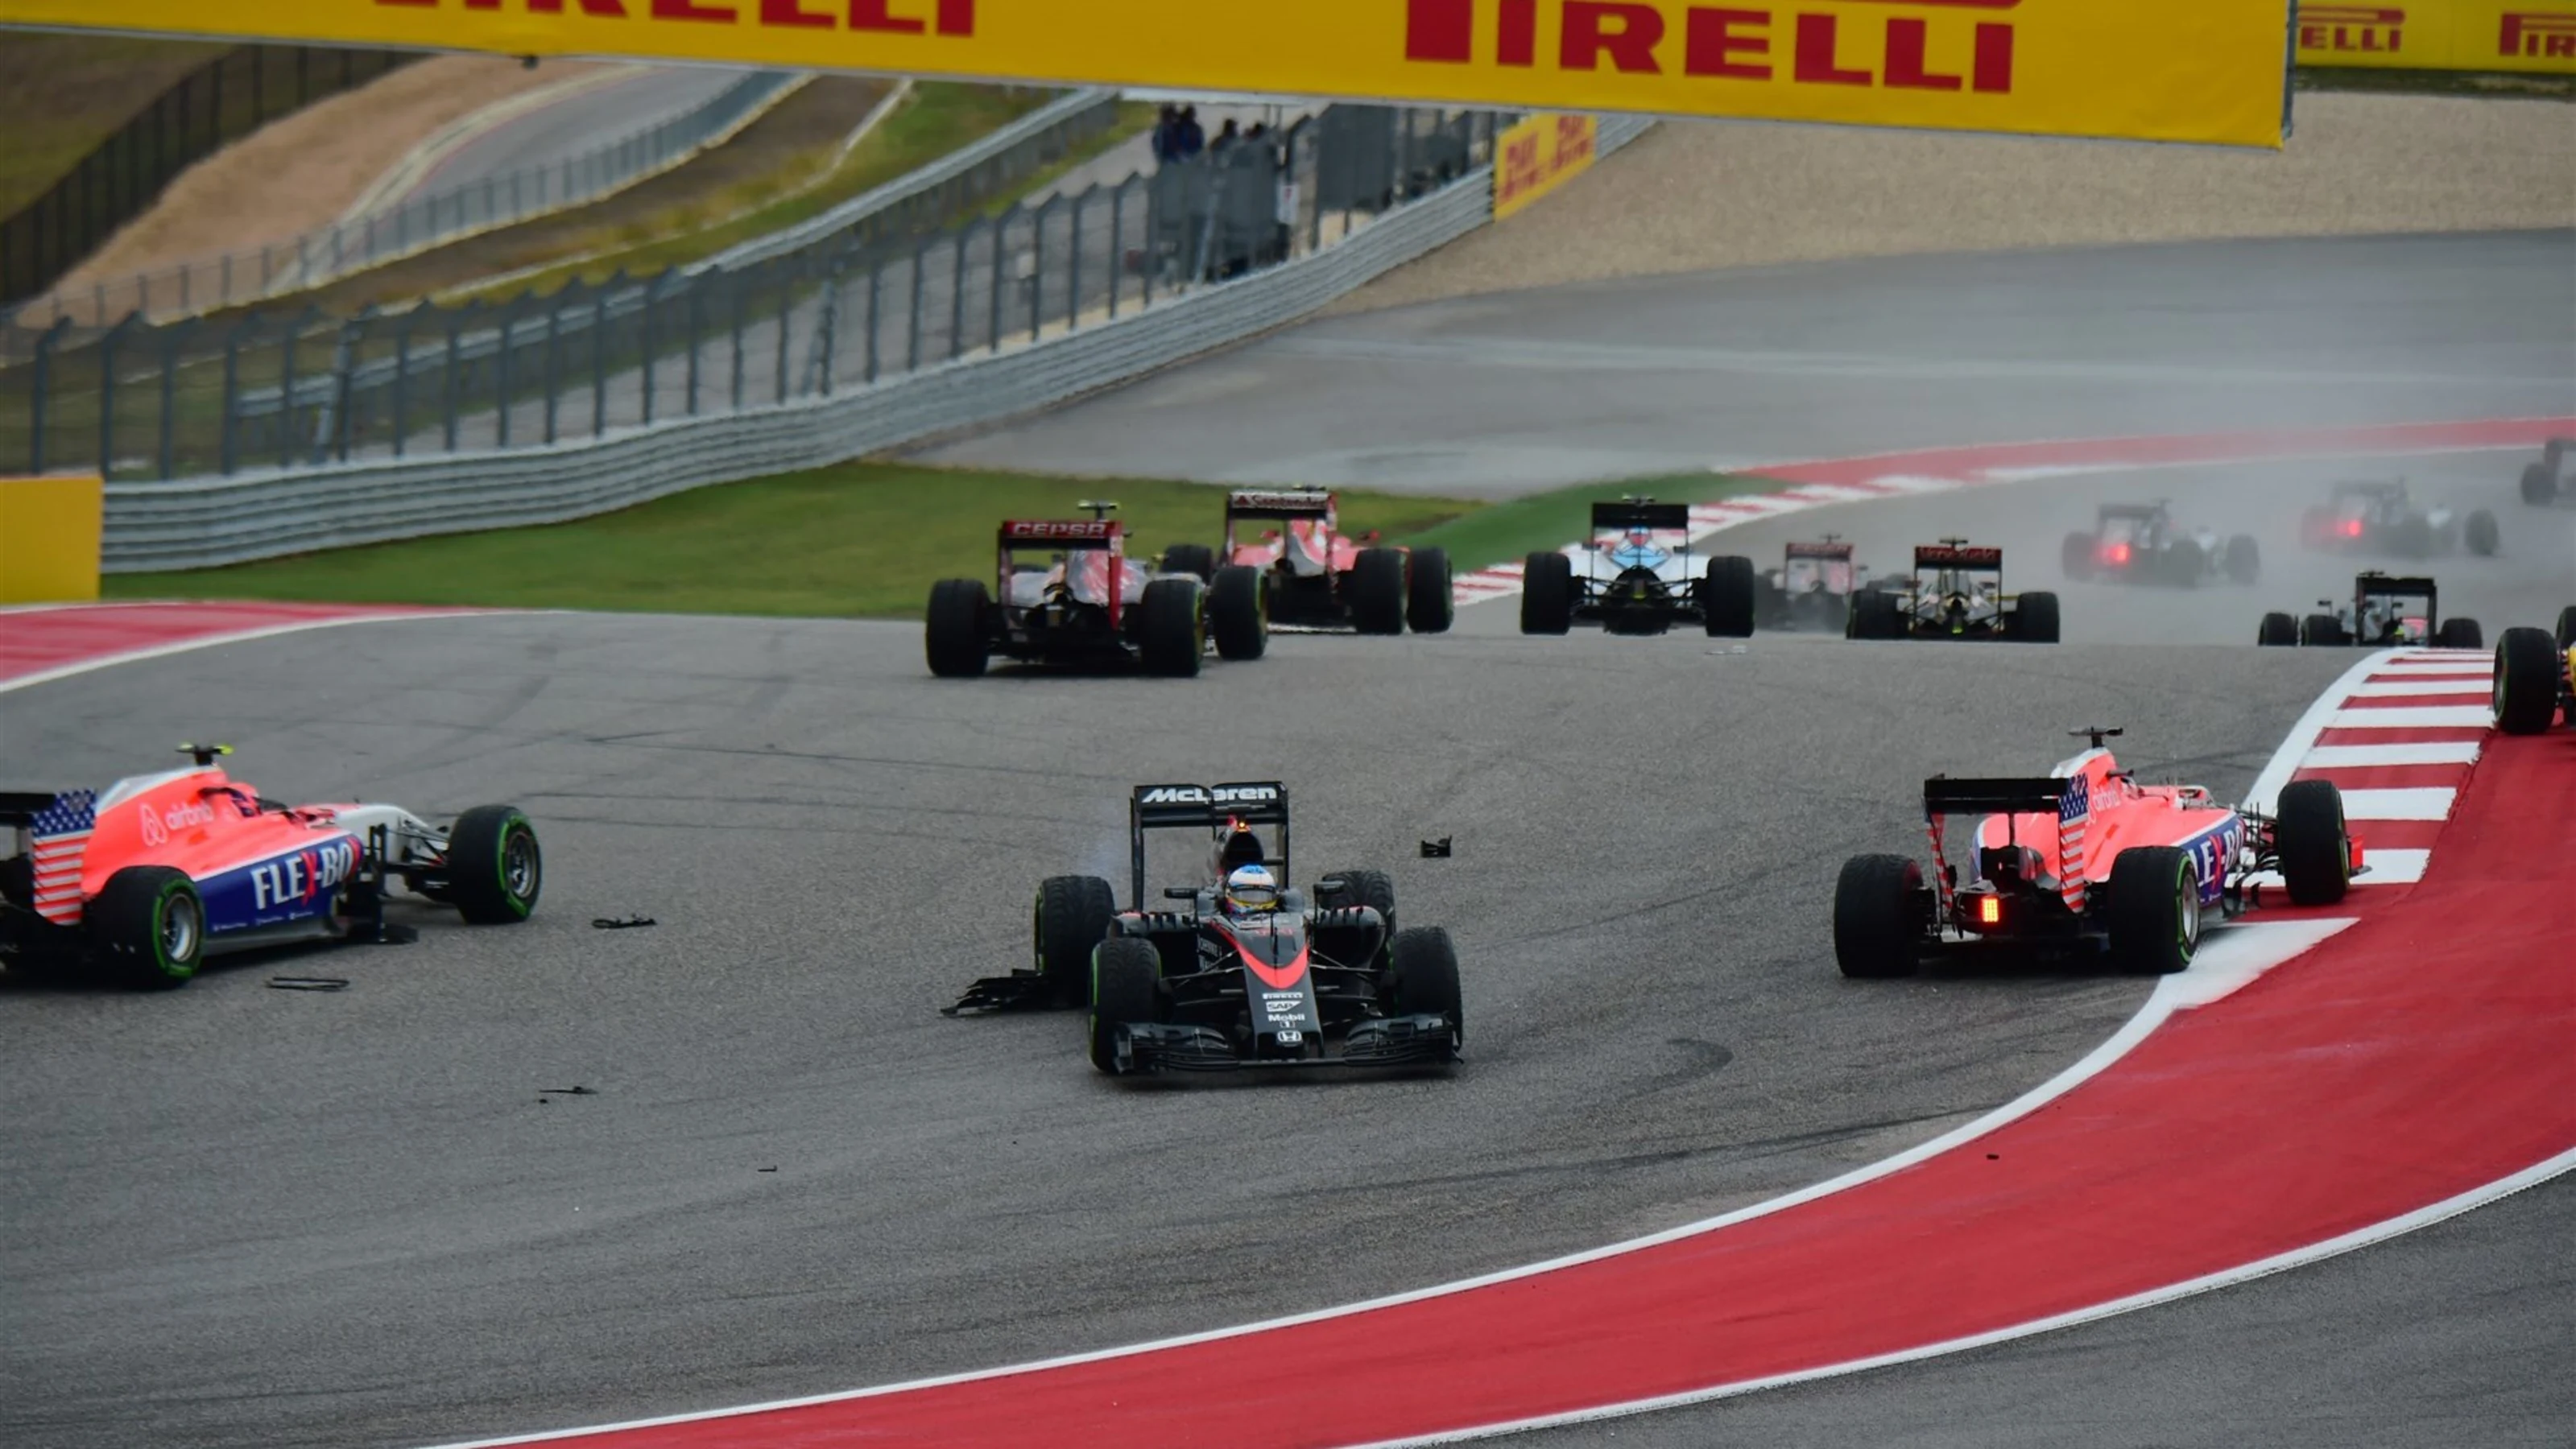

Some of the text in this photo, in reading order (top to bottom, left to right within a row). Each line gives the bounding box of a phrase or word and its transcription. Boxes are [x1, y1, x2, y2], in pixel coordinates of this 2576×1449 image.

[2298, 8, 2404, 52] ELLI
[1013, 522, 1107, 535] CEPSA
[1142, 786, 1277, 804] McLaren
[1267, 1013, 1305, 1022] Mobil
